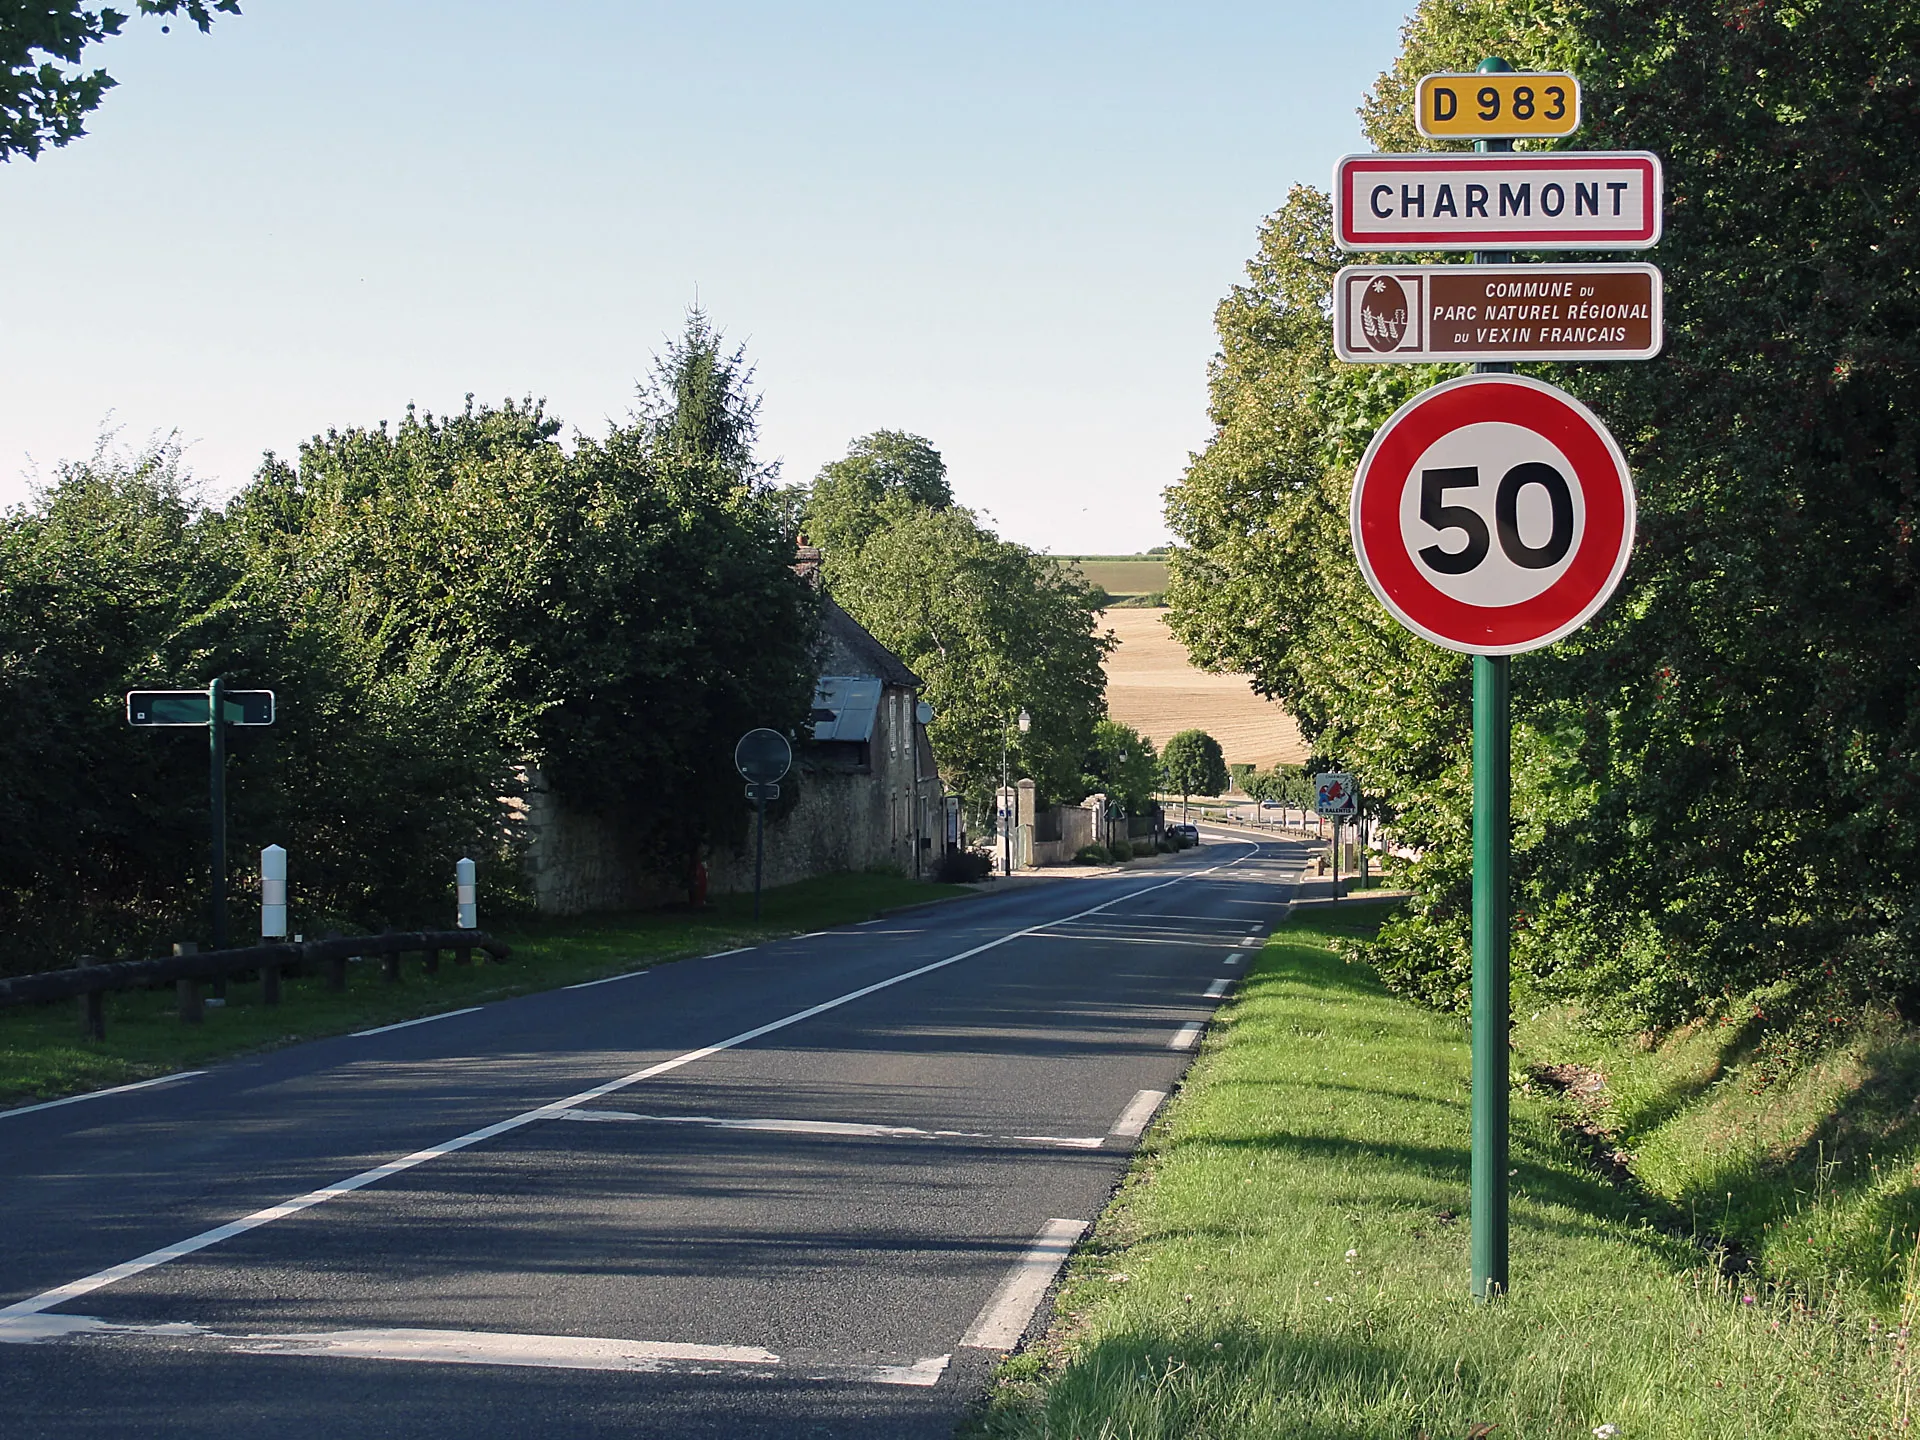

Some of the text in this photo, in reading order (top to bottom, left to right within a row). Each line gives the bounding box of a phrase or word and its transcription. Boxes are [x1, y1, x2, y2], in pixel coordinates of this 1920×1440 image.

[1434, 86, 1566, 121] D 983
[1370, 182, 1628, 218] CHARMONT
[1485, 282, 1573, 297] COMMUNE
[1433, 301, 1649, 321] PARC NATUREL RÉGIONAL
[1476, 328, 1531, 343] VEXIN
[1539, 327, 1626, 344] FRANÇAIS
[1417, 461, 1614, 575] 50
